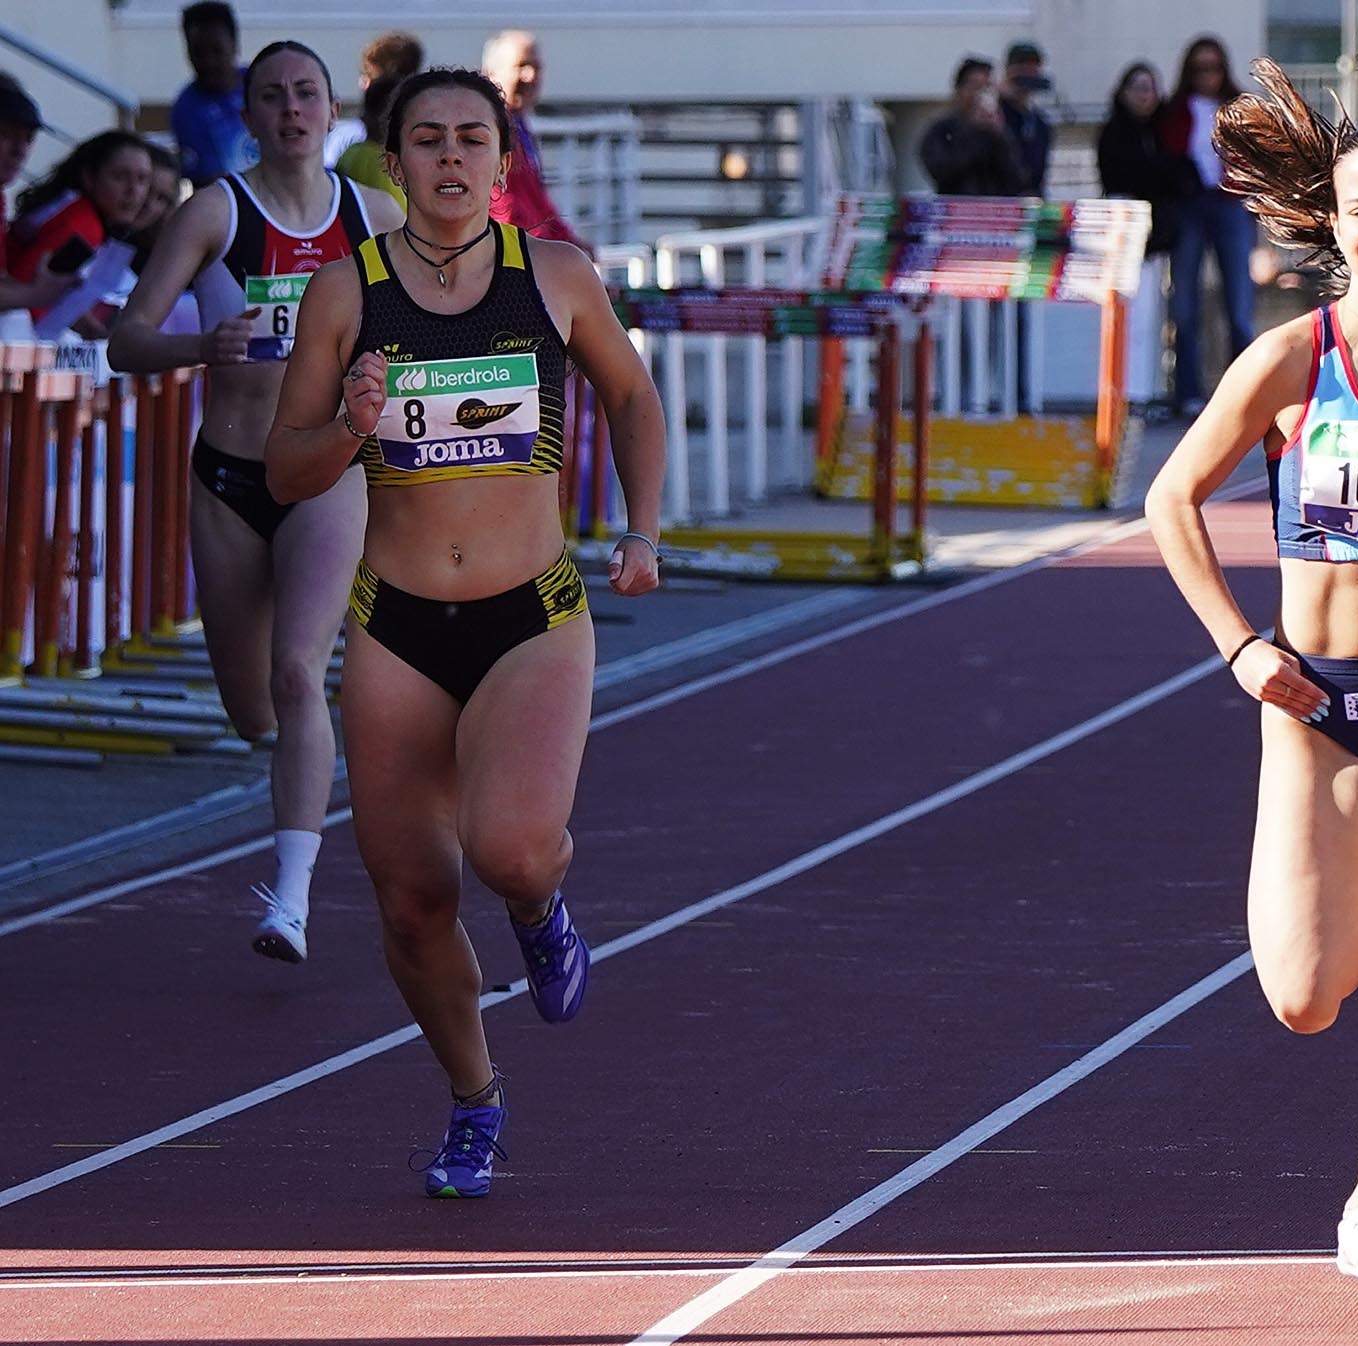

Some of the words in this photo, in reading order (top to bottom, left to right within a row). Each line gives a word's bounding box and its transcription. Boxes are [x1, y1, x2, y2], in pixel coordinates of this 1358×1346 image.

[272, 305, 289, 336] 6
[430, 366, 511, 388] Iberdrola
[403, 398, 427, 440] 8
[460, 405, 509, 421] SPRINT
[413, 437, 505, 467] Joma
